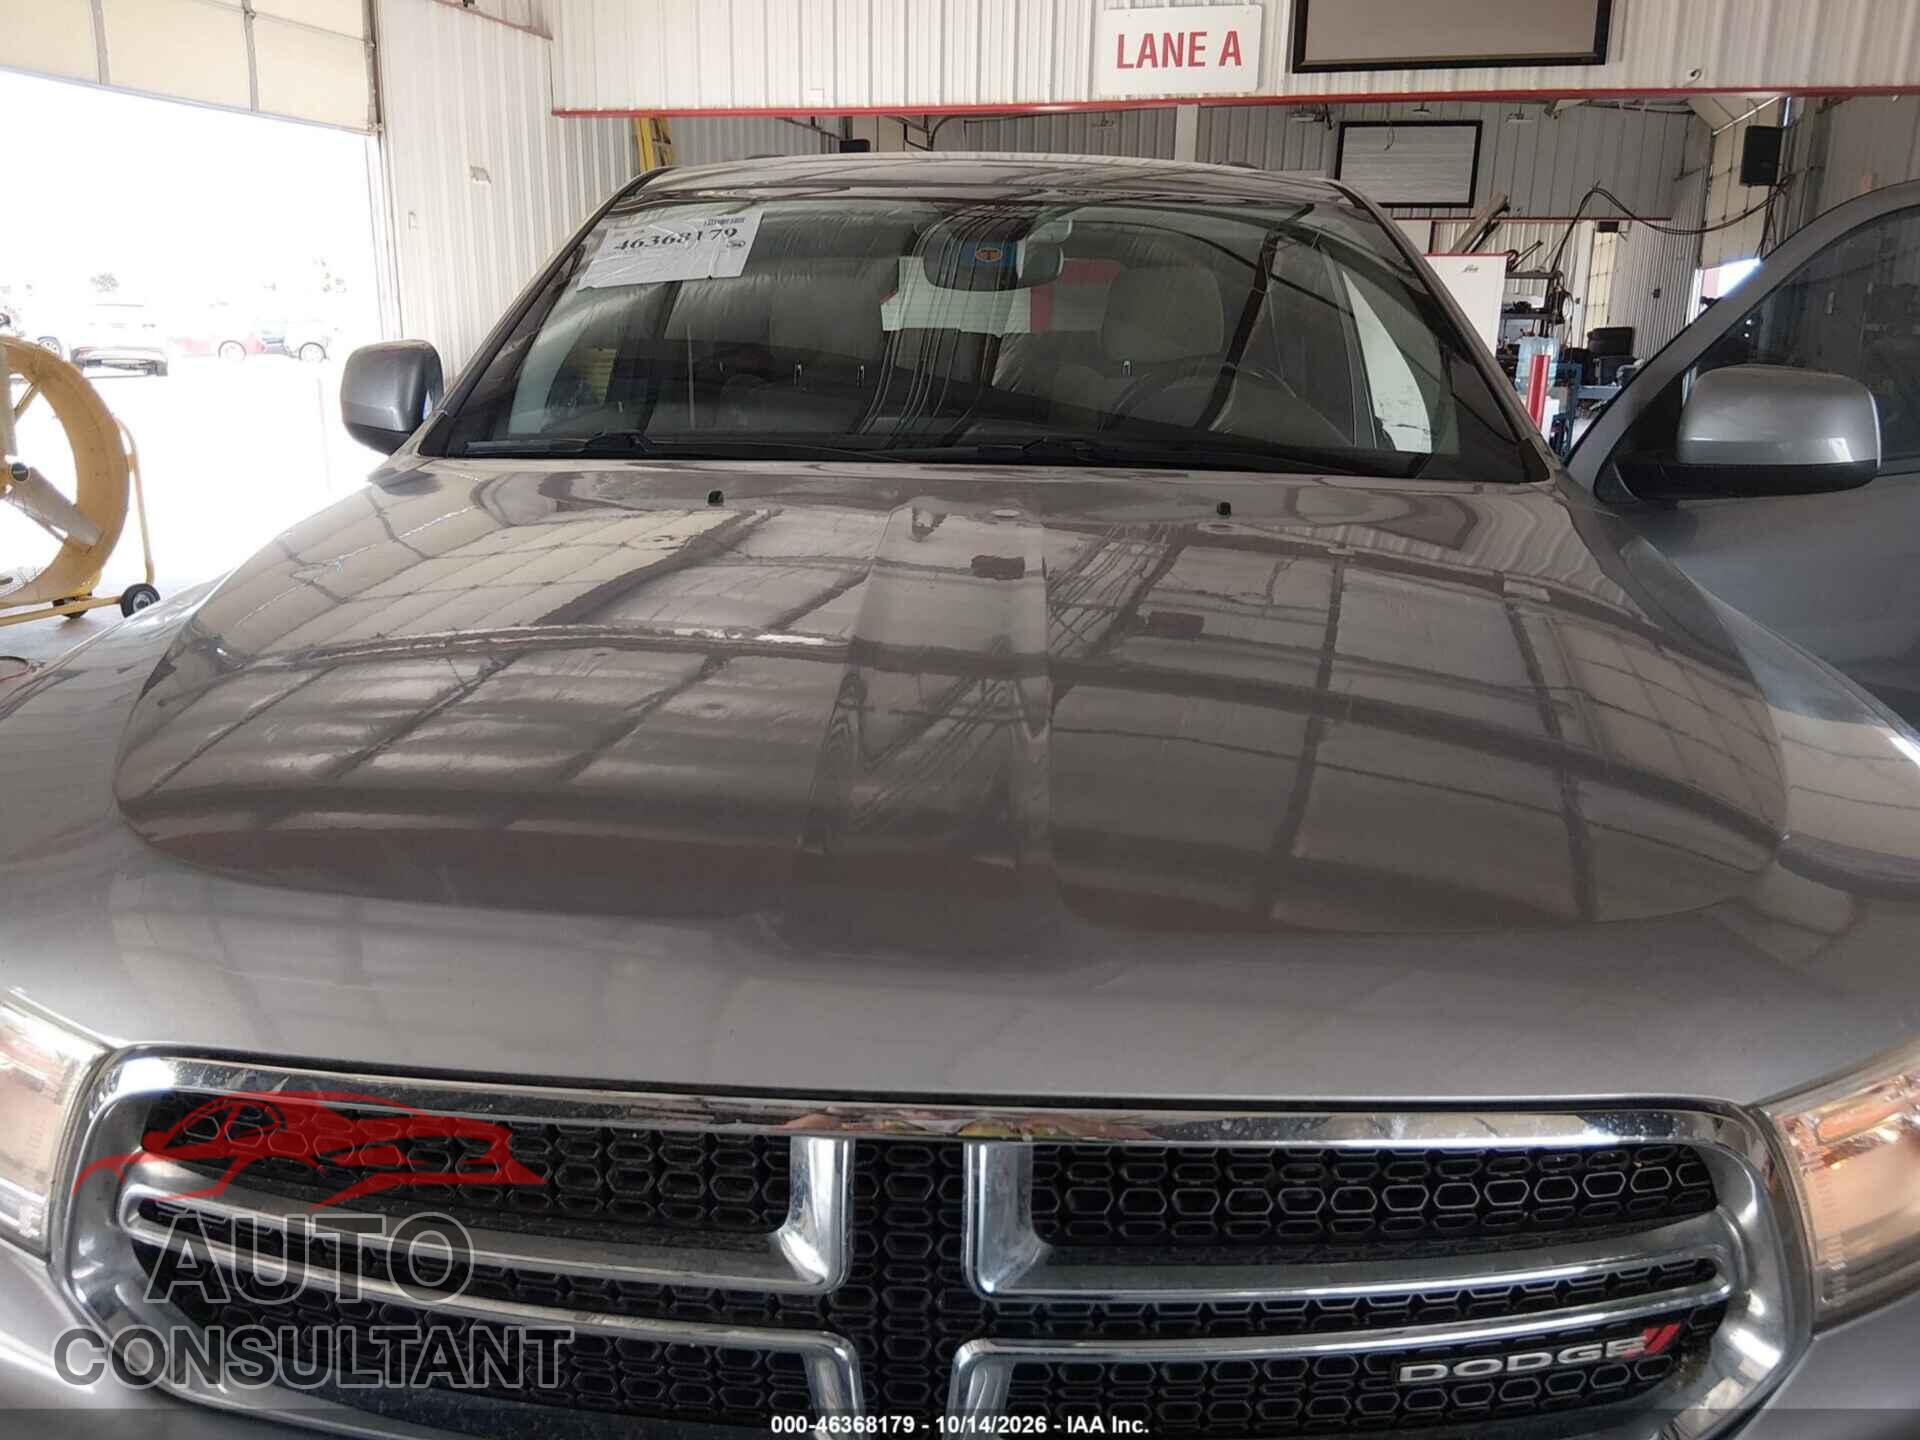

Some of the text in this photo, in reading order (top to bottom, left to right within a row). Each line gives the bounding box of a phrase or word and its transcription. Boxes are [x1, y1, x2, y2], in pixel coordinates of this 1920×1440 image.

[1116, 30, 1243, 69] LANE A
[614, 227, 738, 250] 46368179
[1399, 1336, 1648, 1383] DODGE
